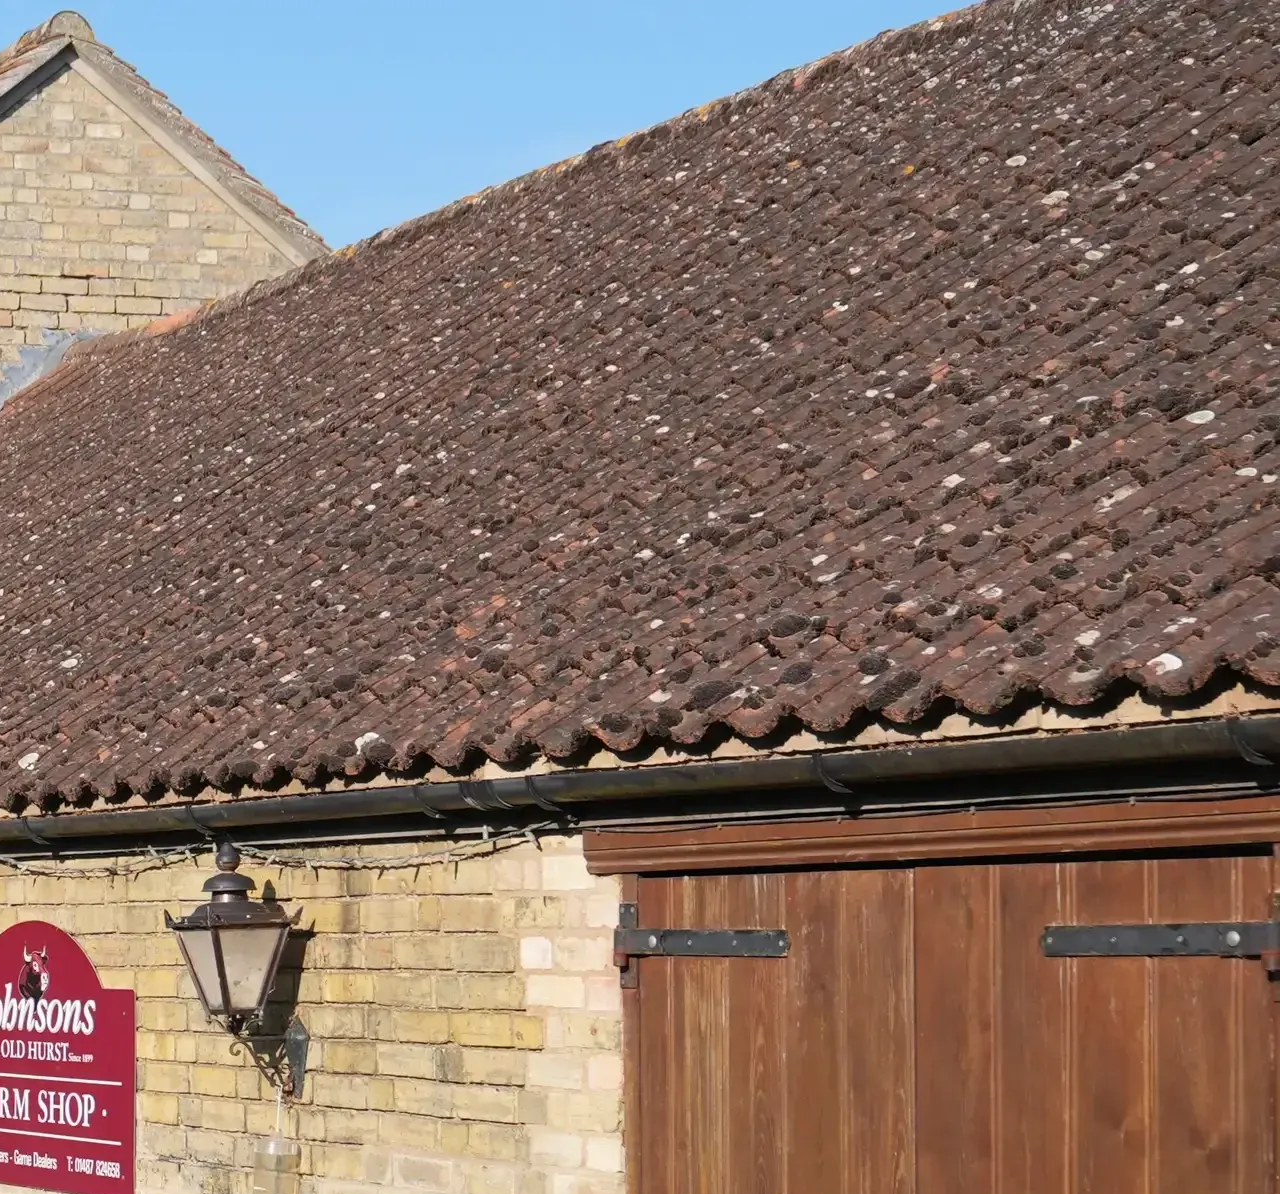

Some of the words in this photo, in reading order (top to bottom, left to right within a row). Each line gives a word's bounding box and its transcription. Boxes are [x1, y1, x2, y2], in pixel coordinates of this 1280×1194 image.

[0, 1039, 25, 1059] OLD
[27, 1041, 69, 1062] HURST
[37, 1091, 95, 1127] SHOP
[13, 1150, 32, 1166] Game
[33, 1152, 57, 1170] Dealers
[67, 1156, 73, 1172] T:
[75, 1159, 93, 1174] 01487
[96, 1161, 120, 1178] 824658
